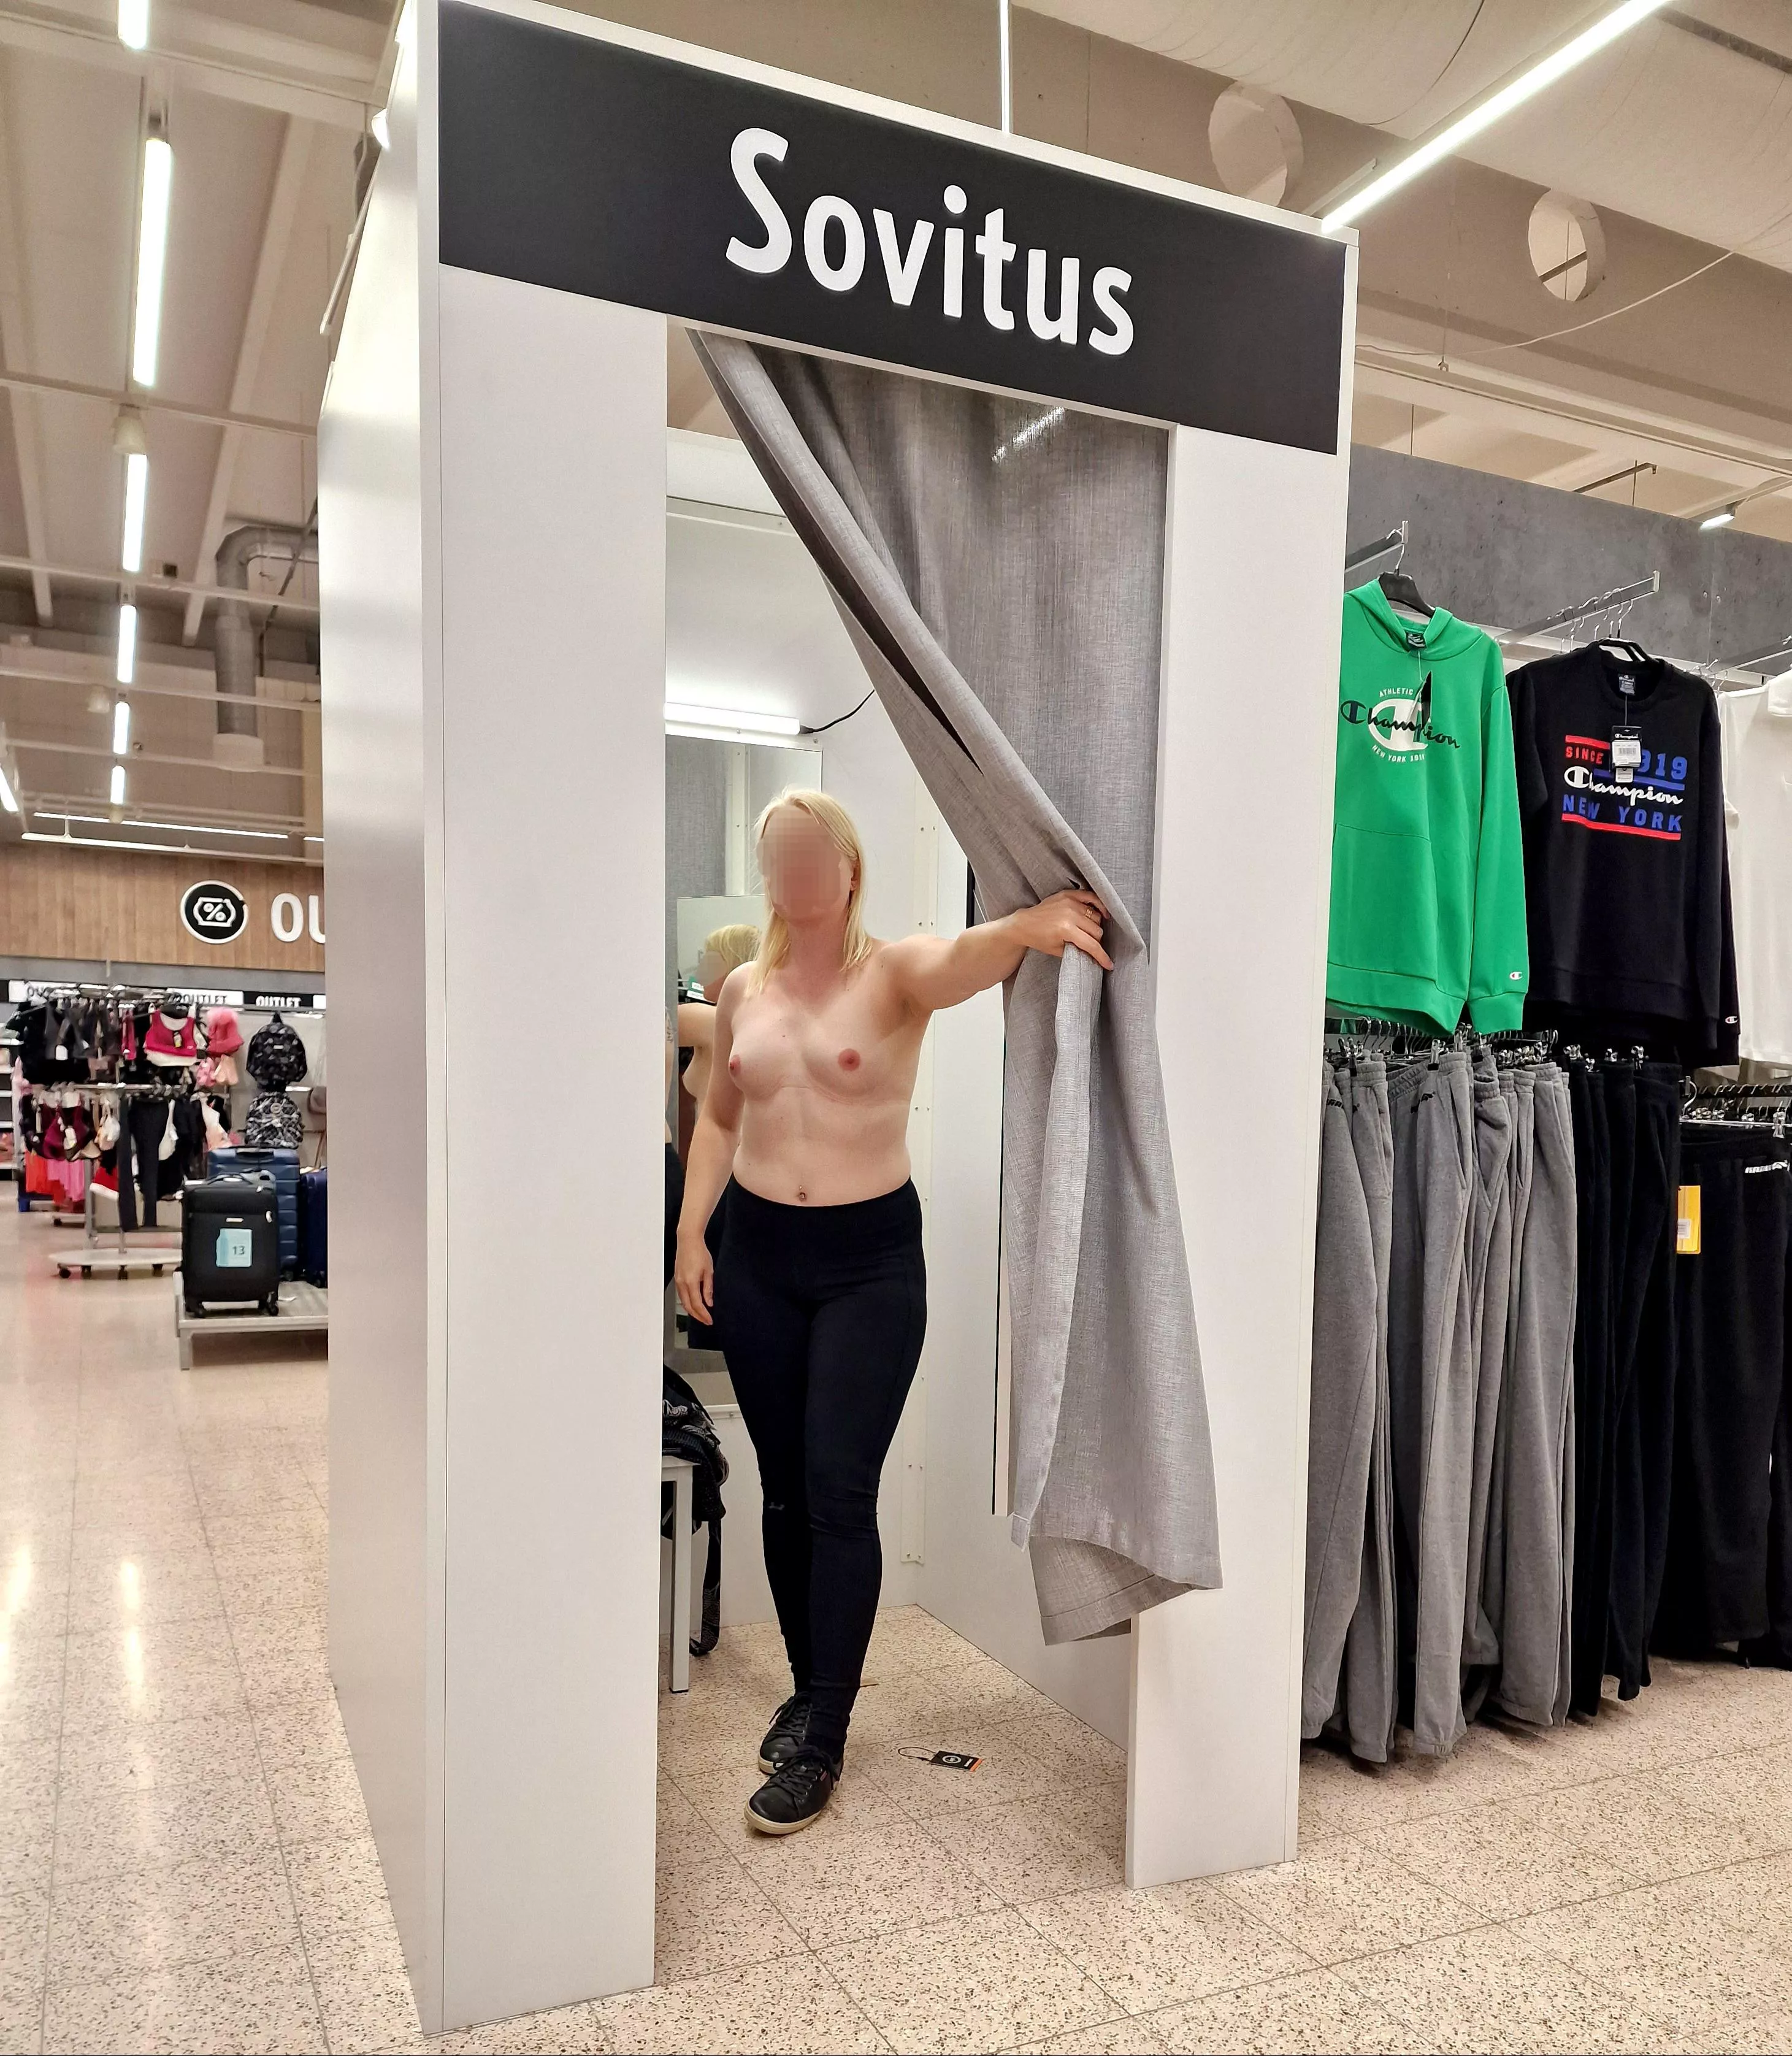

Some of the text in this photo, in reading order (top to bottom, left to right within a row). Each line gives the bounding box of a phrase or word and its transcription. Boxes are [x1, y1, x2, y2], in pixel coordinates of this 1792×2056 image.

[726, 127, 1134, 356] Sovitus
[1379, 688, 1414, 697] ATHLETIC
[1372, 745, 1385, 758] NEW
[1388, 754, 1407, 762] YORK
[1566, 746, 1604, 764] SINCE
[1637, 749, 1687, 780] 919
[1564, 765, 1683, 807] Champion
[1563, 794, 1683, 832] NEW YORK
[255, 995, 302, 1008] OUTLET
[232, 1246, 245, 1256] 13
